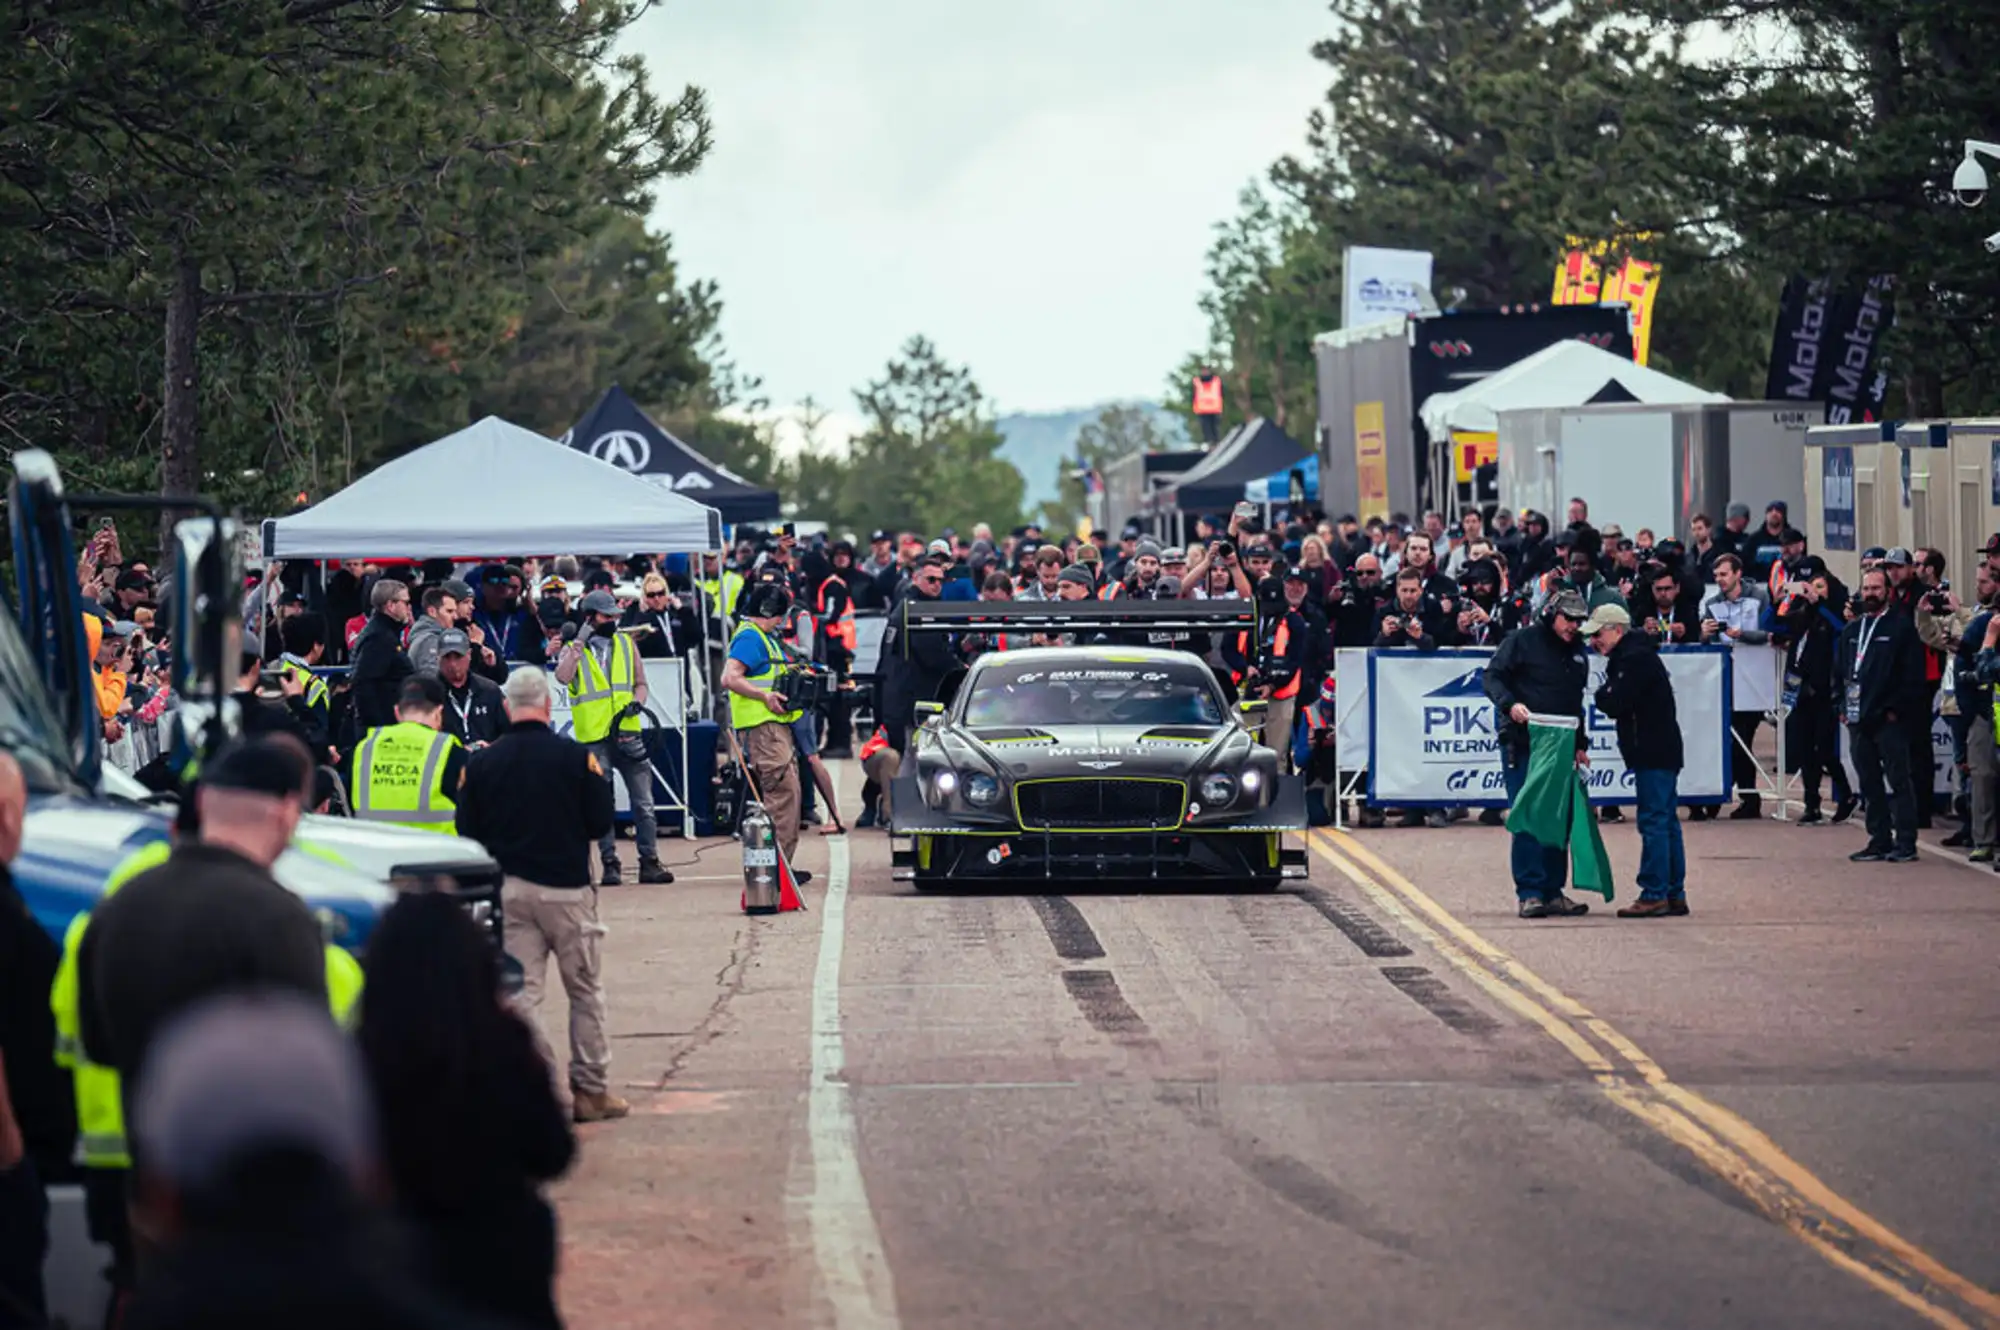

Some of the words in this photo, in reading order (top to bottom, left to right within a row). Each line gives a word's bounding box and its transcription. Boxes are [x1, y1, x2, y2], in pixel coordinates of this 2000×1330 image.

[1423, 705, 1491, 735] PIK
[1048, 745, 1120, 757] Mobil
[1423, 739, 1502, 753] INTERNA
[373, 764, 420, 776] MEDIA
[373, 777, 417, 786] AFFILIATE
[1481, 770, 1505, 790] GR
